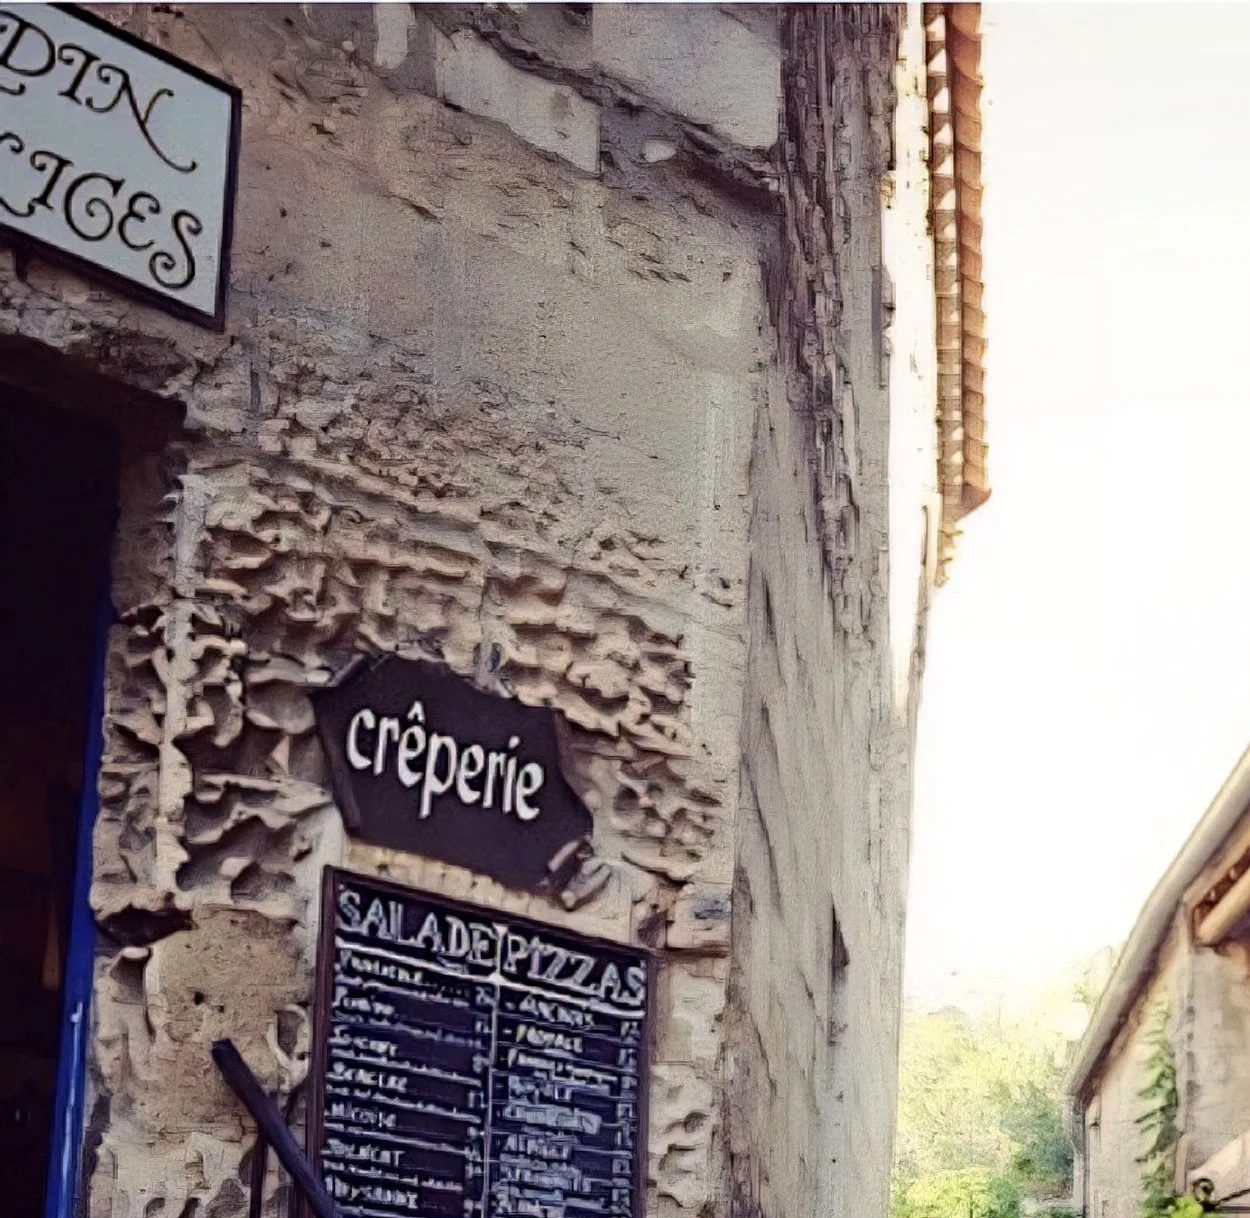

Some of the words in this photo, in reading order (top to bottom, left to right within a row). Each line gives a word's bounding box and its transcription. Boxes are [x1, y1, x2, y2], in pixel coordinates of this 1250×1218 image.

[0, 9, 198, 173] DIN
[346, 700, 544, 820] crêperie
[503, 934, 646, 1007] PIZZAS
